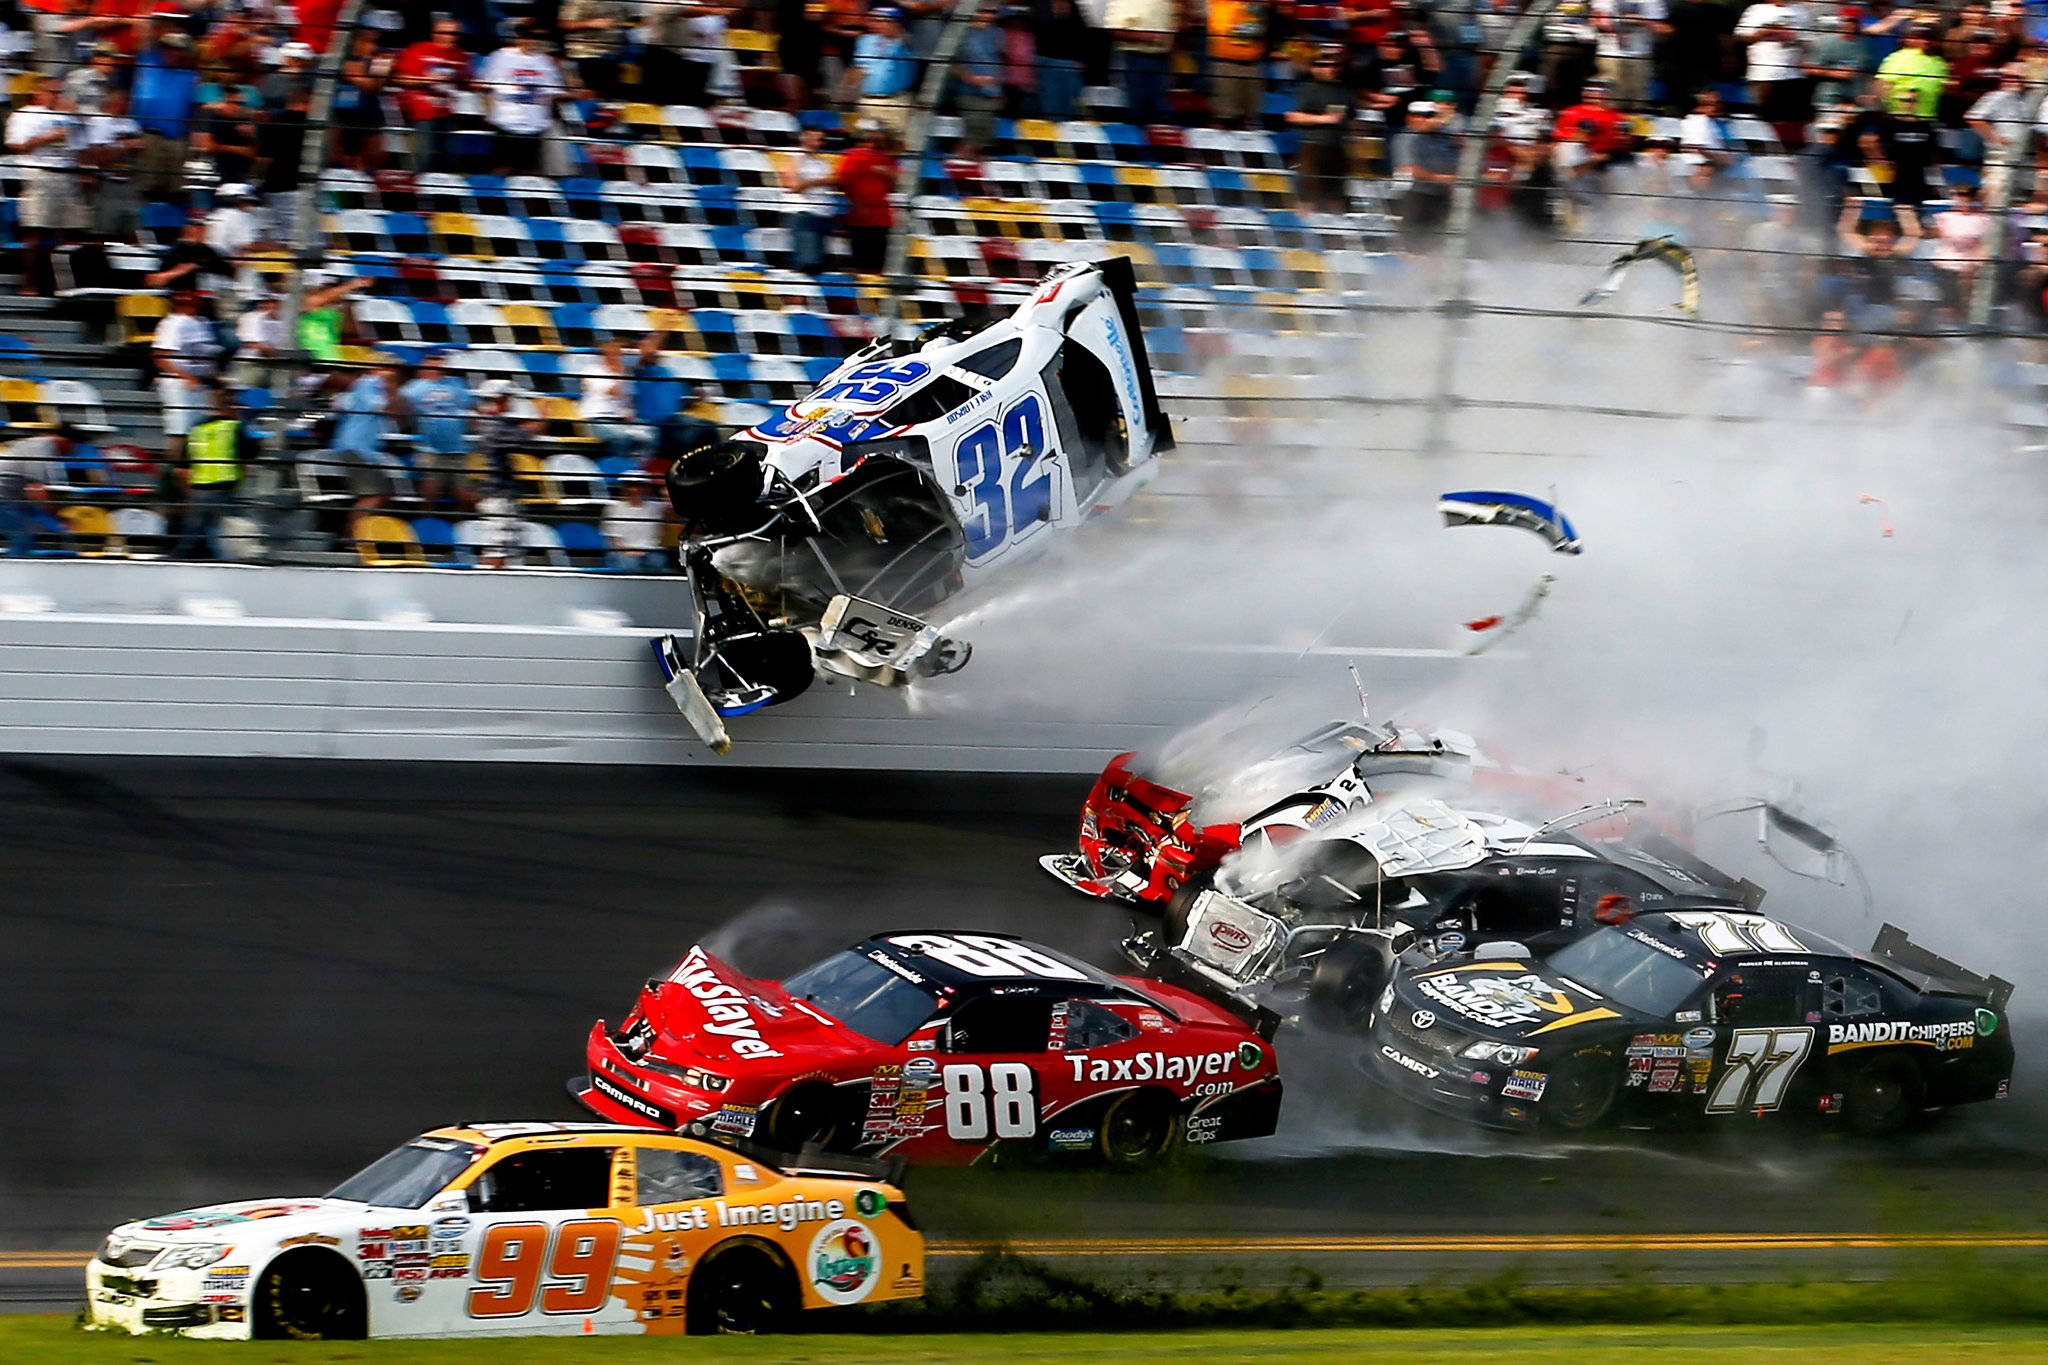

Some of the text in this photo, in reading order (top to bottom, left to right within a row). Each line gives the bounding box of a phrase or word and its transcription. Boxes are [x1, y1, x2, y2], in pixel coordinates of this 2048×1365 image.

[955, 391, 1051, 560] 32
[887, 616, 923, 633] DENSO
[1634, 931, 1687, 959] Nationwide
[1664, 911, 1812, 958] 77
[877, 953, 924, 984] Nationwide
[886, 934, 1088, 981] 88
[1428, 973, 1542, 1025] BANDIT
[1064, 1049, 1236, 1087] TaxSlayer
[1381, 1045, 1440, 1080] CAMRY
[1513, 1069, 1547, 1081] MOOG
[1705, 1026, 1815, 1115] 77
[594, 1076, 660, 1119] CAMARO
[1190, 1081, 1234, 1098] .com
[1507, 1077, 1544, 1091] MAHLE
[722, 1103, 758, 1114] MOOG
[942, 1062, 1037, 1140] 88
[717, 1113, 756, 1126] MAHLE
[1050, 1129, 1094, 1140] Goody's
[1186, 1116, 1222, 1129] Great
[1186, 1129, 1217, 1144] Clips
[637, 1194, 845, 1234] Just Imagine
[467, 1217, 624, 1319] 99
